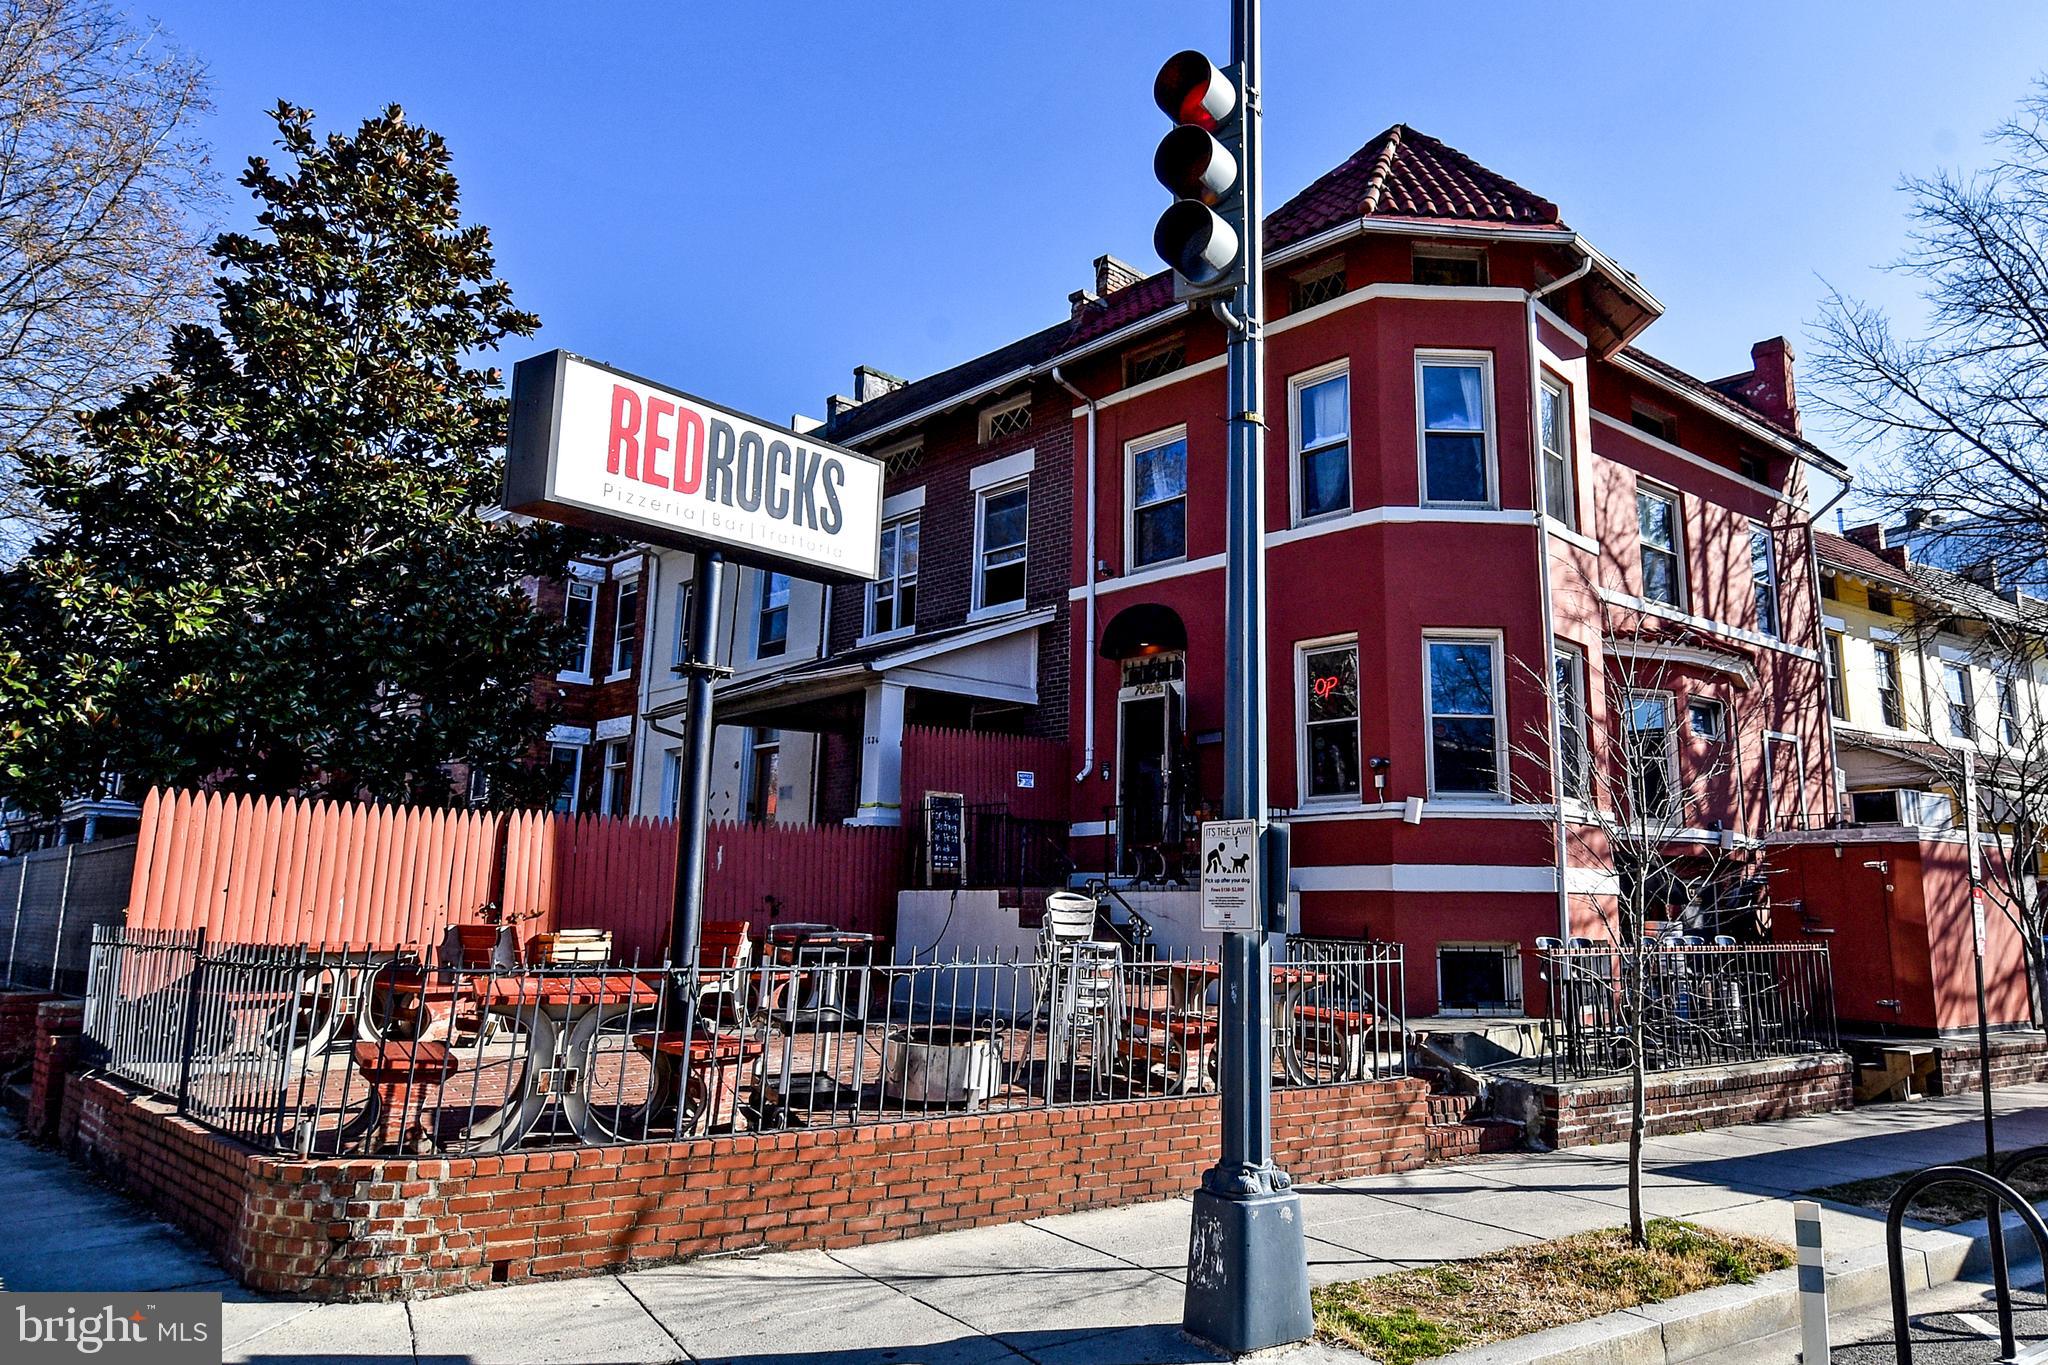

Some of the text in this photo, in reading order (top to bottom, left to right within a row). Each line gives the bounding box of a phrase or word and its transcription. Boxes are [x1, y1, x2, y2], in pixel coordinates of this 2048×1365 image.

[603, 482, 695, 520] Pizzeria
[1217, 826, 1231, 836] THE
[1232, 825, 1251, 836] LAW!
